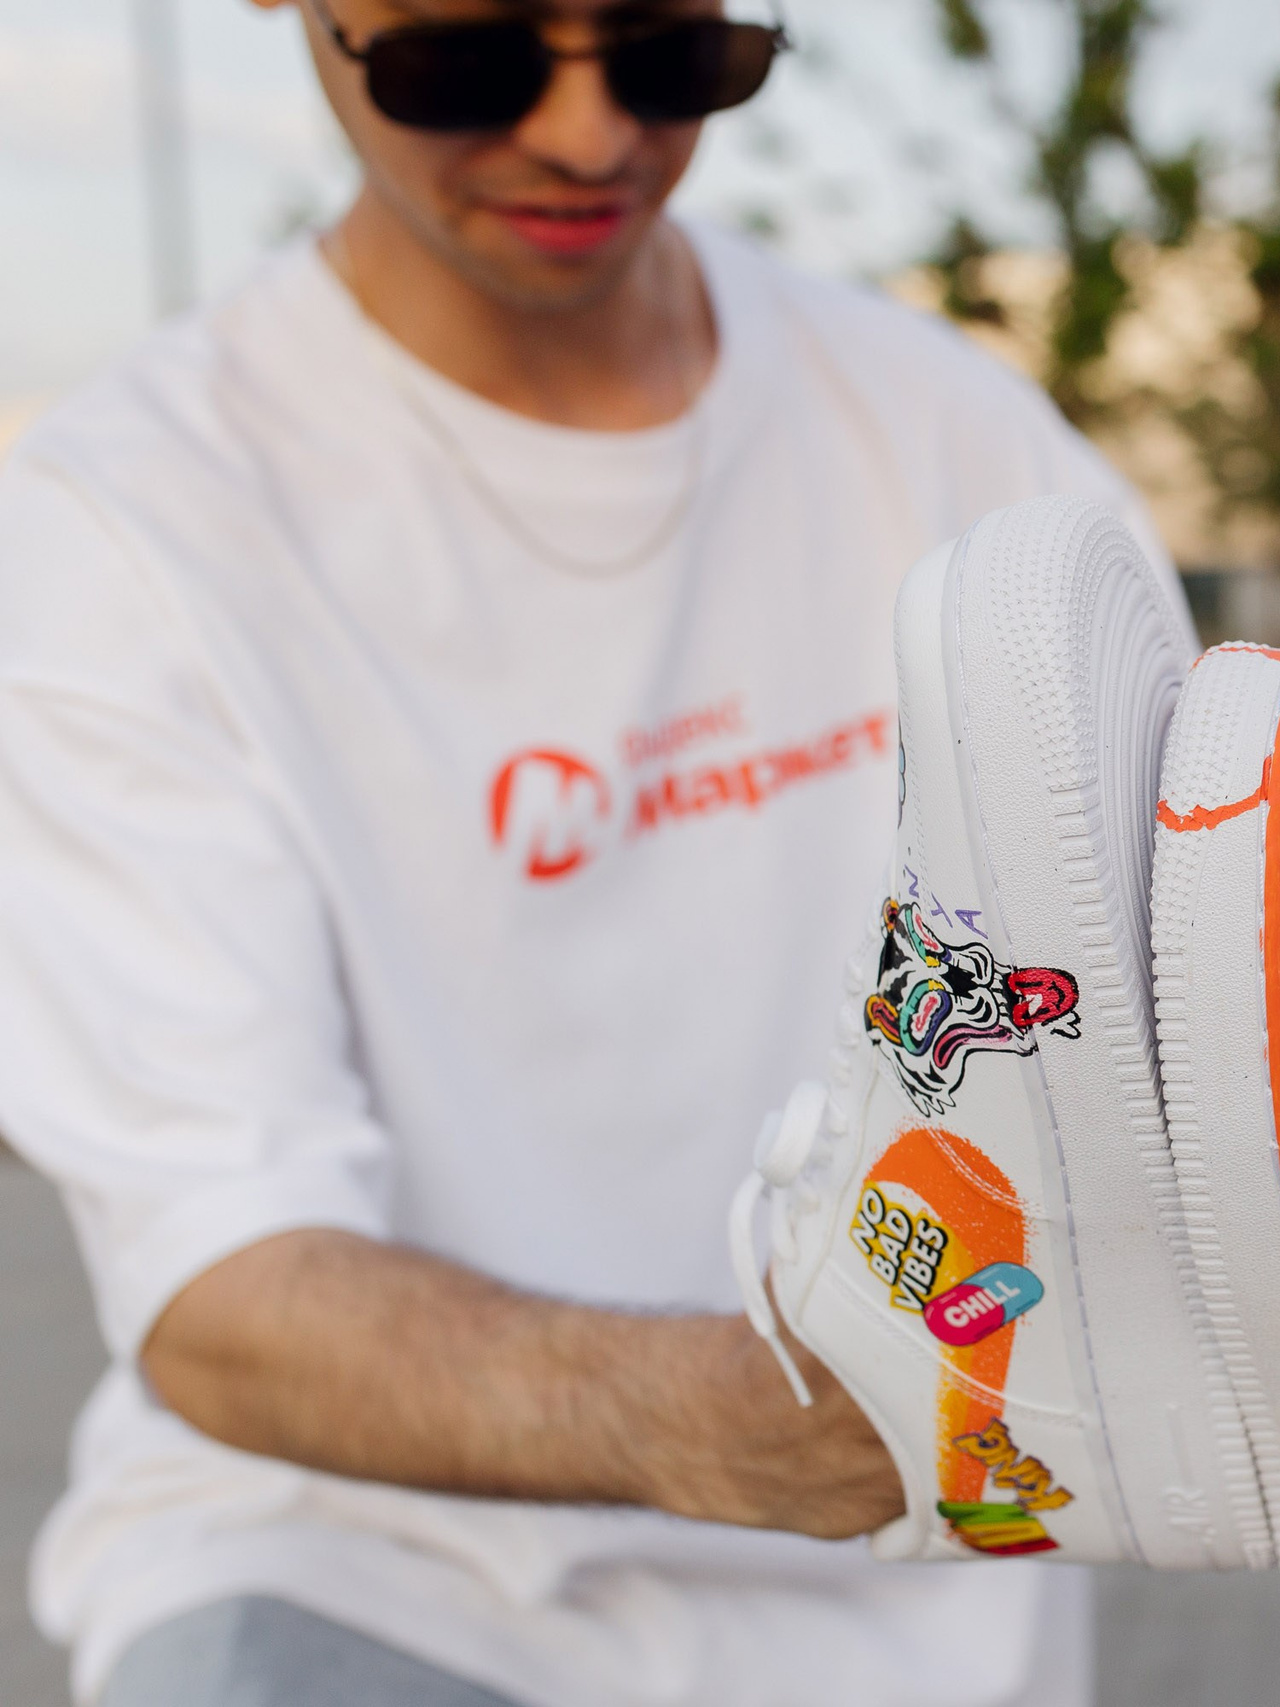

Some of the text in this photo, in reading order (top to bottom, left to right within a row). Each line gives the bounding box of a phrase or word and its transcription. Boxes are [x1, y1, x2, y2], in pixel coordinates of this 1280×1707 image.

[850, 1187, 886, 1255] NO
[870, 1208, 914, 1286] BAD
[894, 1218, 949, 1312] VIBES
[943, 1281, 1021, 1328] CHILL
